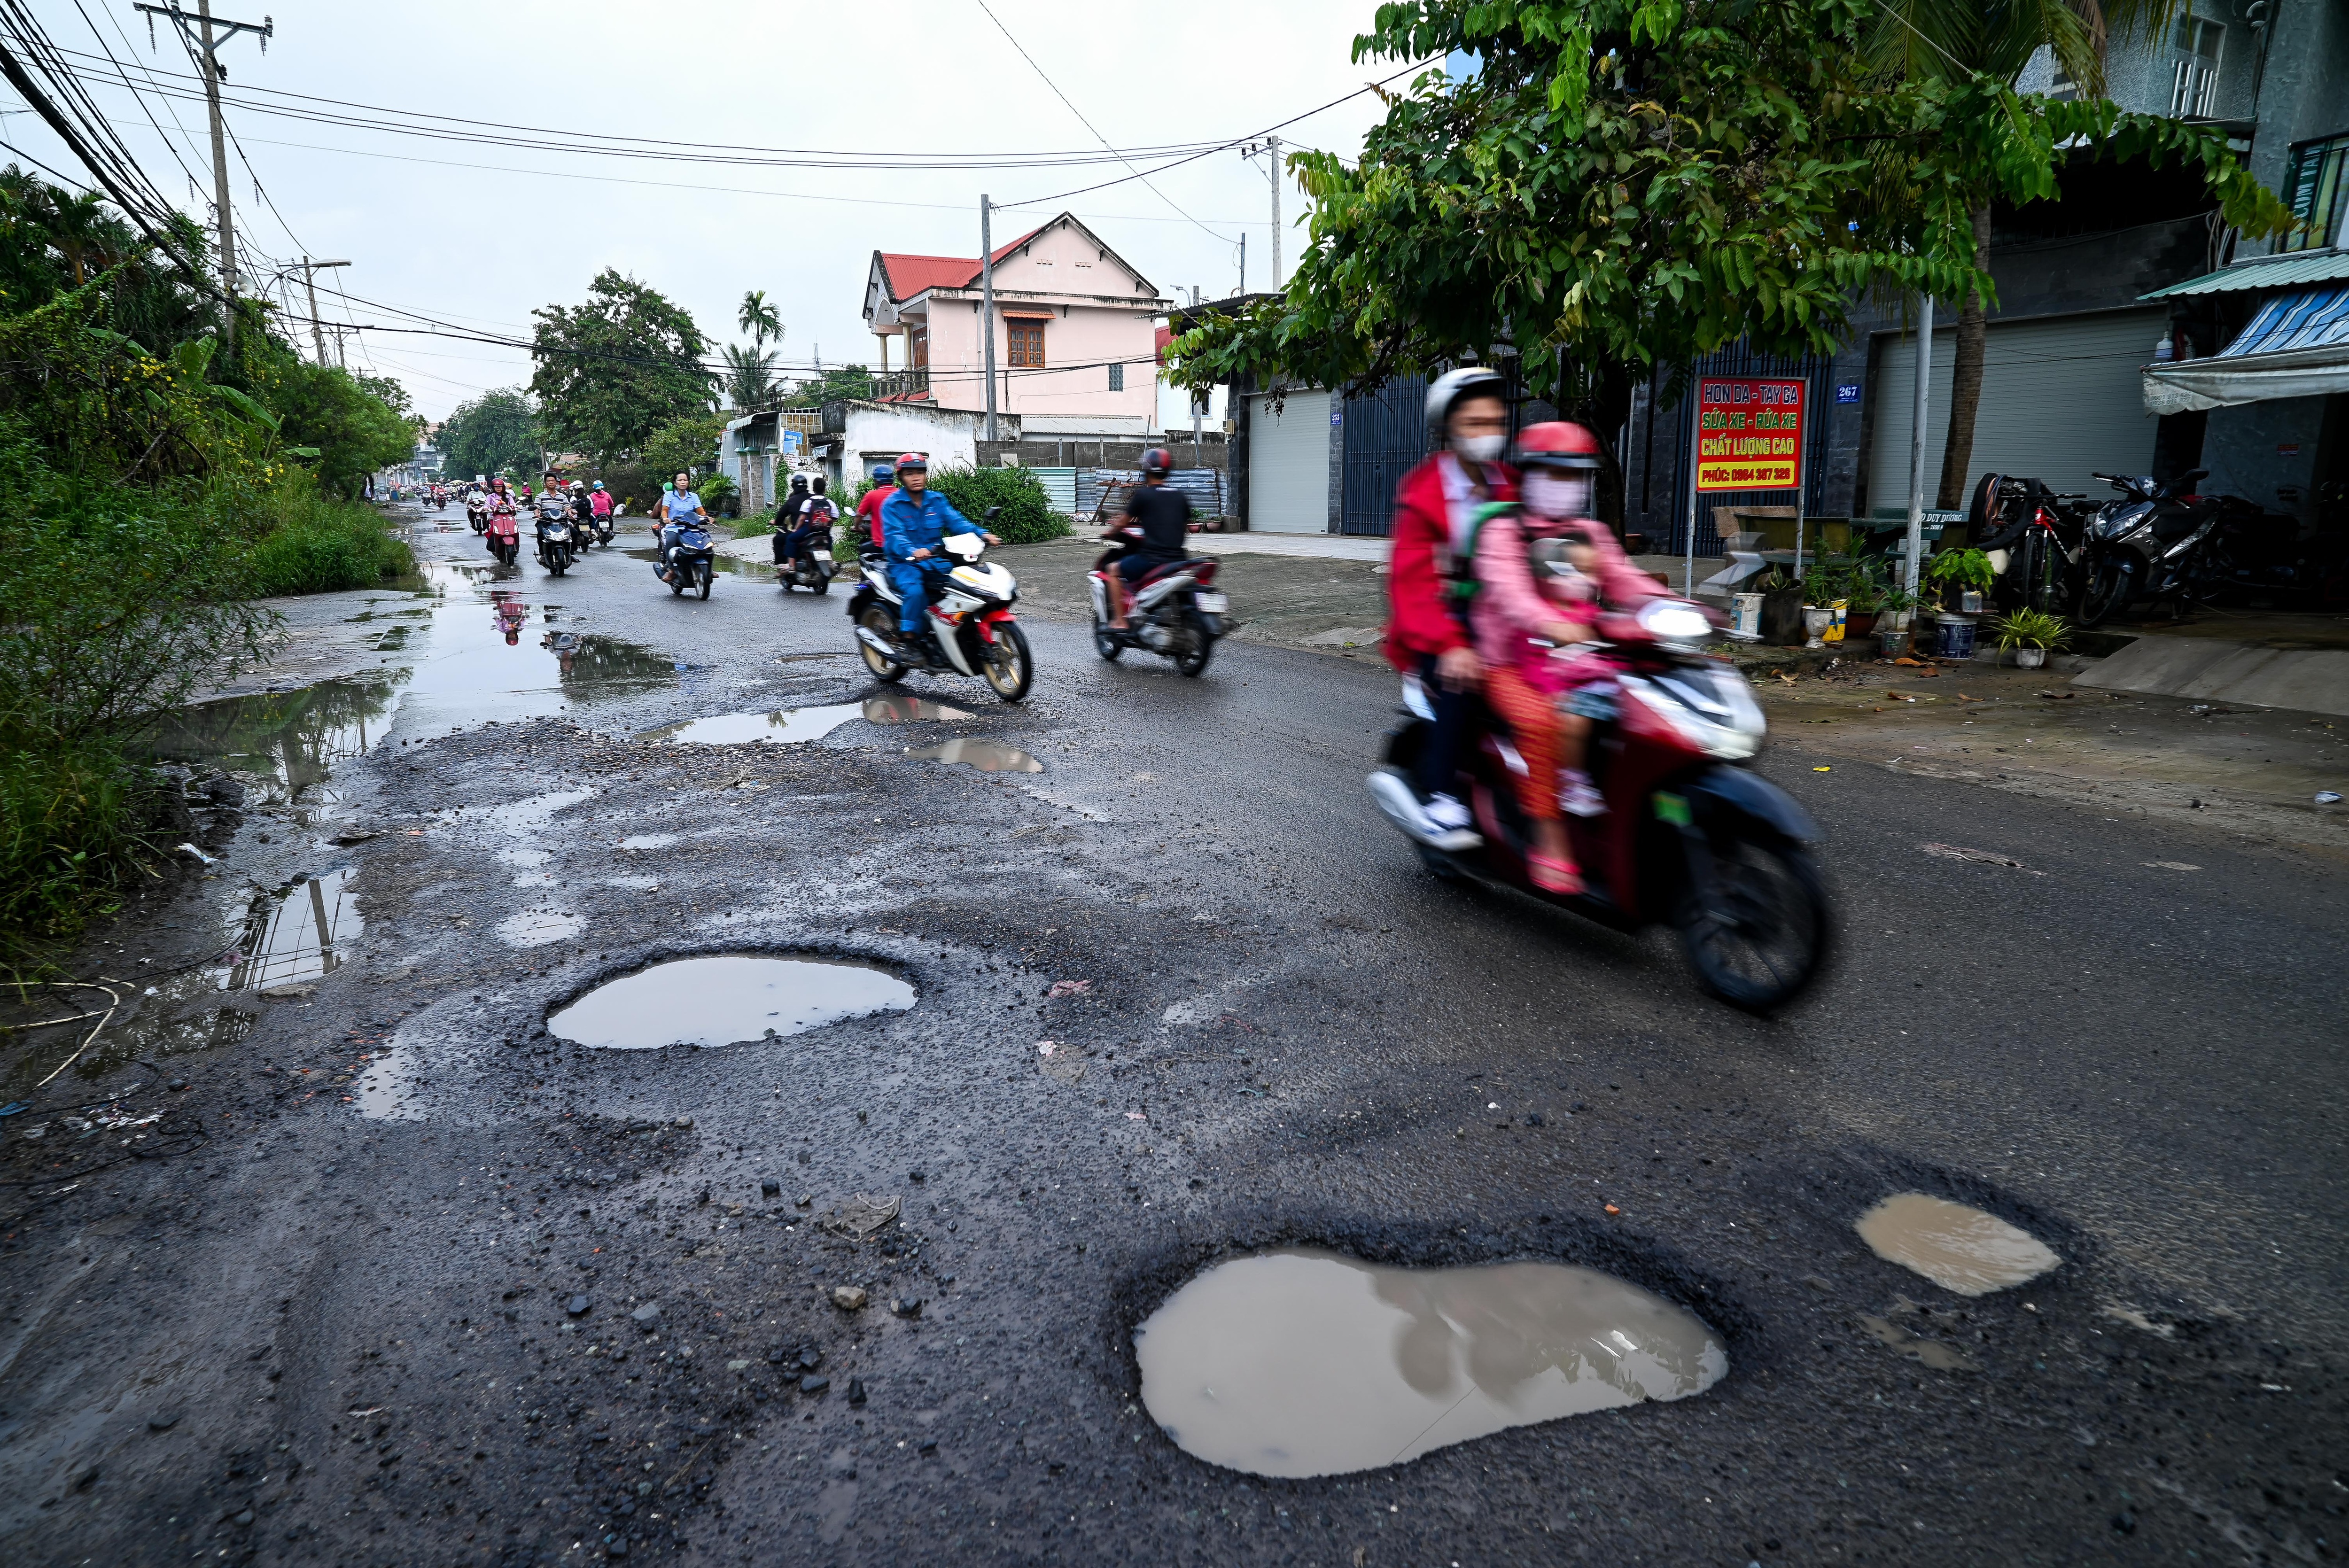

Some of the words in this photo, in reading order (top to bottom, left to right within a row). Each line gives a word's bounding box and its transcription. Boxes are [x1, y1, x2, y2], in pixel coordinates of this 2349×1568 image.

[1704, 384, 1731, 404] HON
[1733, 384, 1750, 404] DA
[1759, 385, 1781, 404] TAY
[1782, 386, 1798, 404] GA
[1838, 386, 1858, 396] 267
[1702, 407, 1727, 429] SỬA
[1729, 412, 1746, 429] XE
[1755, 408, 1780, 429] RỬA
[1781, 412, 1797, 429] XE
[1702, 433, 1732, 456] CHẤT
[1733, 437, 1771, 458] LƯỢNG
[1773, 437, 1795, 455] CAO
[1702, 466, 1730, 483] PHÚC:
[1927, 513, 1941, 522] DUY
